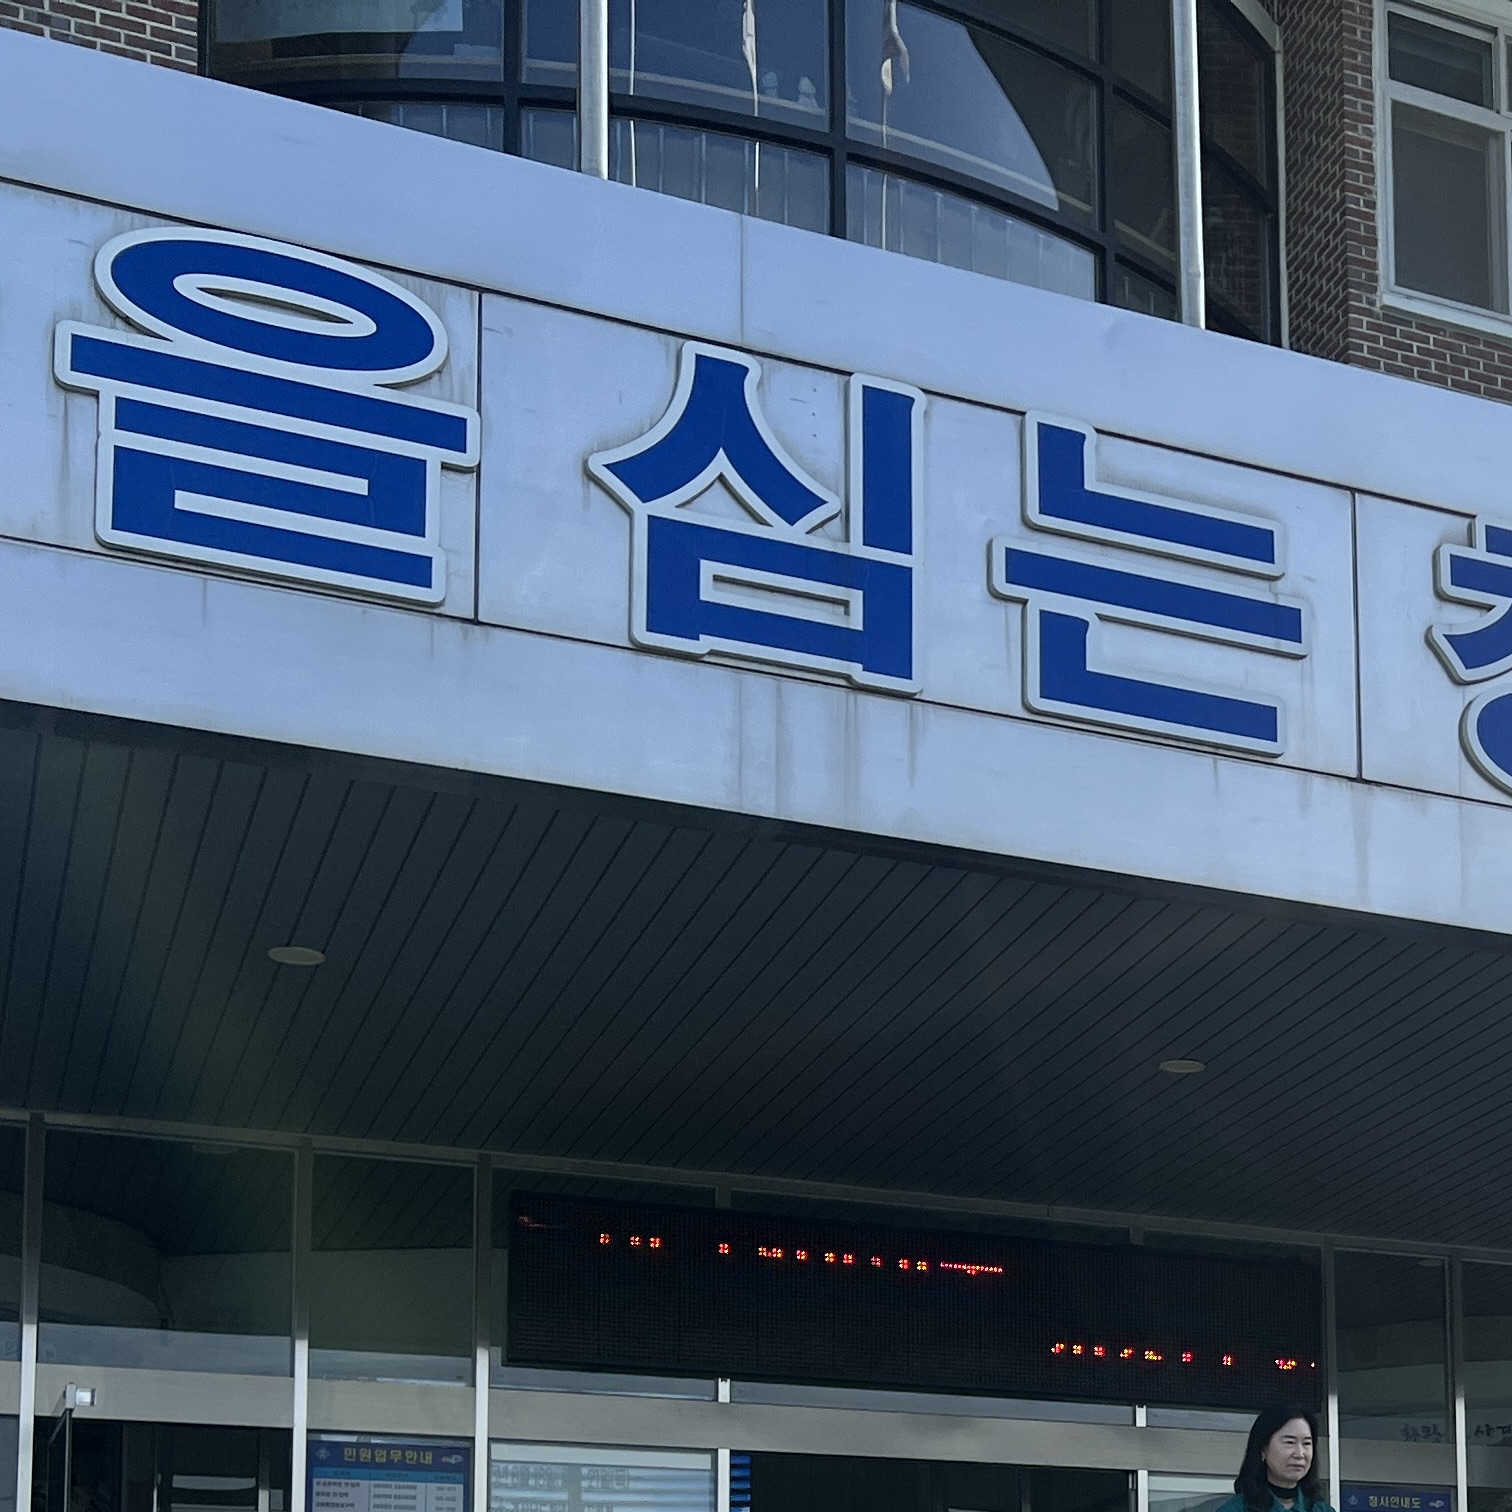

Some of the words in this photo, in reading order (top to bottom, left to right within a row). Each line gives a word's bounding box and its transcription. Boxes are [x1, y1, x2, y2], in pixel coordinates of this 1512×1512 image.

[54, 227, 480, 604] 을
[588, 341, 1307, 758] 심는
[343, 1447, 433, 1465] 민원업무안내
[1368, 1495, 1421, 1509] 청사안내도
